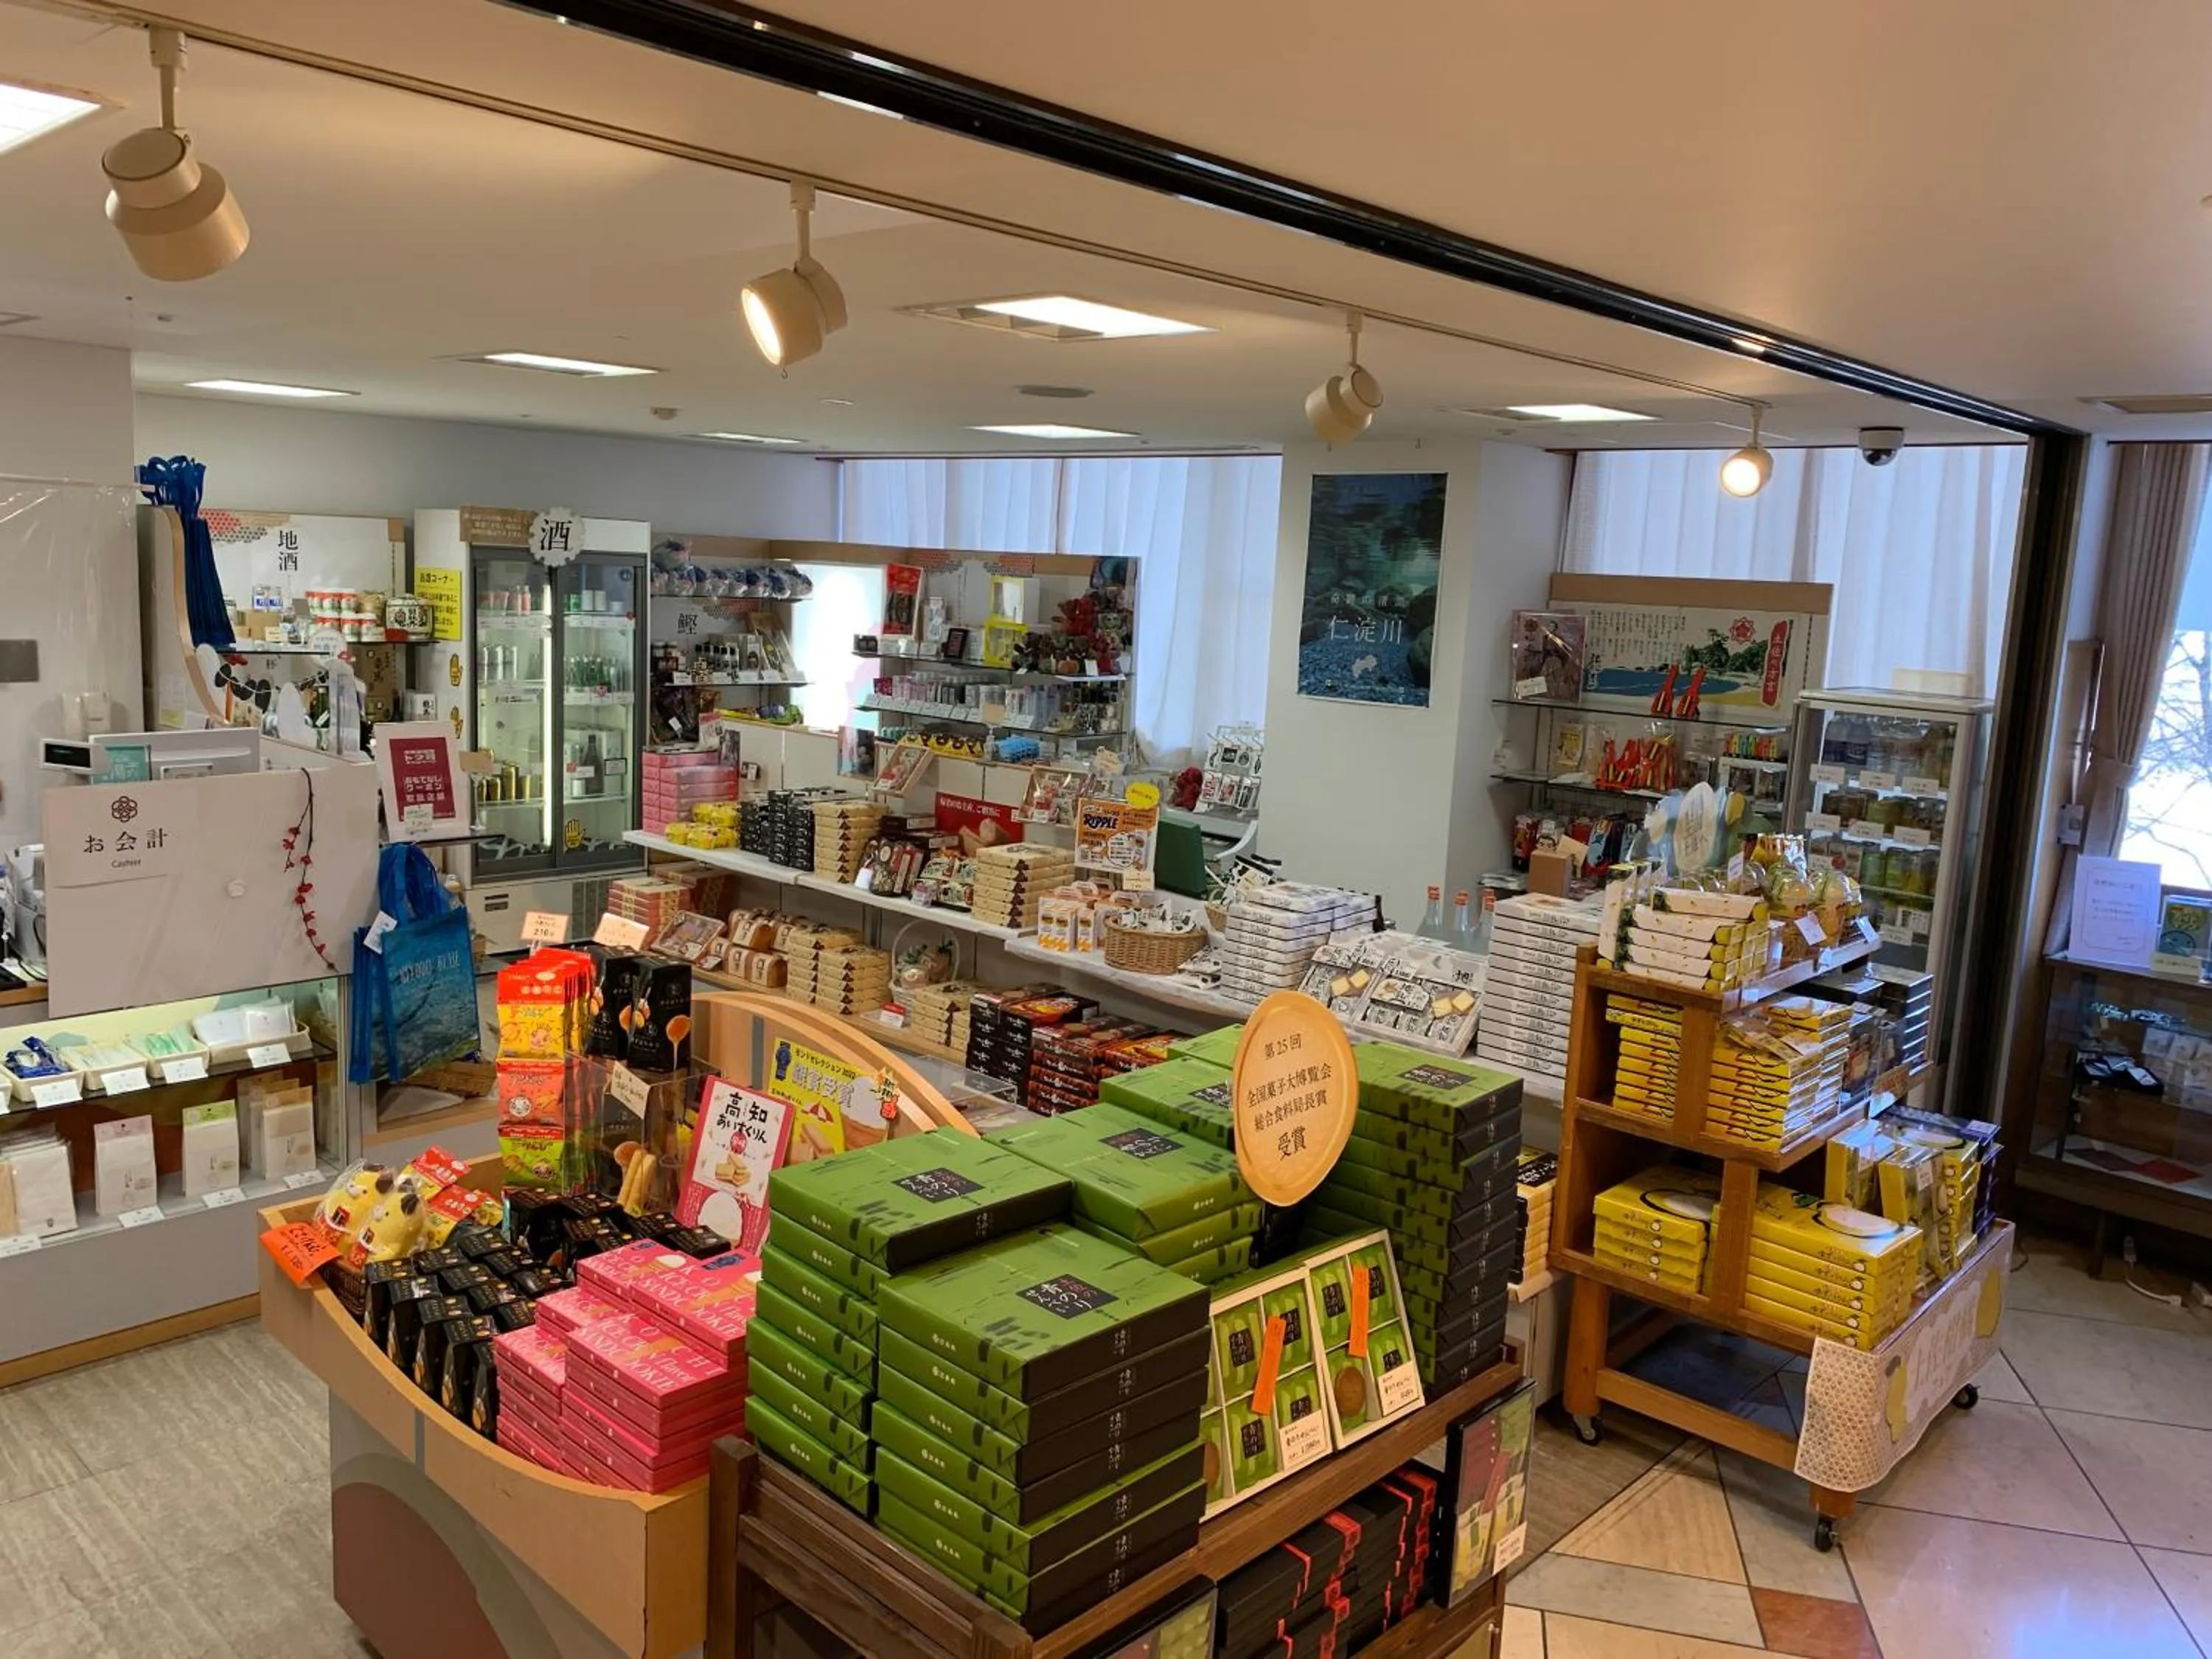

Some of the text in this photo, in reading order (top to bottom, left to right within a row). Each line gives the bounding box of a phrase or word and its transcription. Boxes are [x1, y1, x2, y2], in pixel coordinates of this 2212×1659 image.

[539, 518, 572, 552] 酒
[278, 530, 299, 572] 地酒
[1328, 615, 1403, 645] 仁淀川
[406, 783, 443, 792] クーポン
[1083, 813, 1118, 830] RIPPLE
[83, 827, 168, 854] お会計
[795, 1048, 842, 1074] モンドセレクション
[1264, 1033, 1303, 1061] 第25回
[1246, 1062, 1332, 1109] 全国菓子大博覧会
[724, 1091, 768, 1124] 高知
[716, 1113, 767, 1144] あいすくりん
[1276, 1125, 1307, 1162] 受賞
